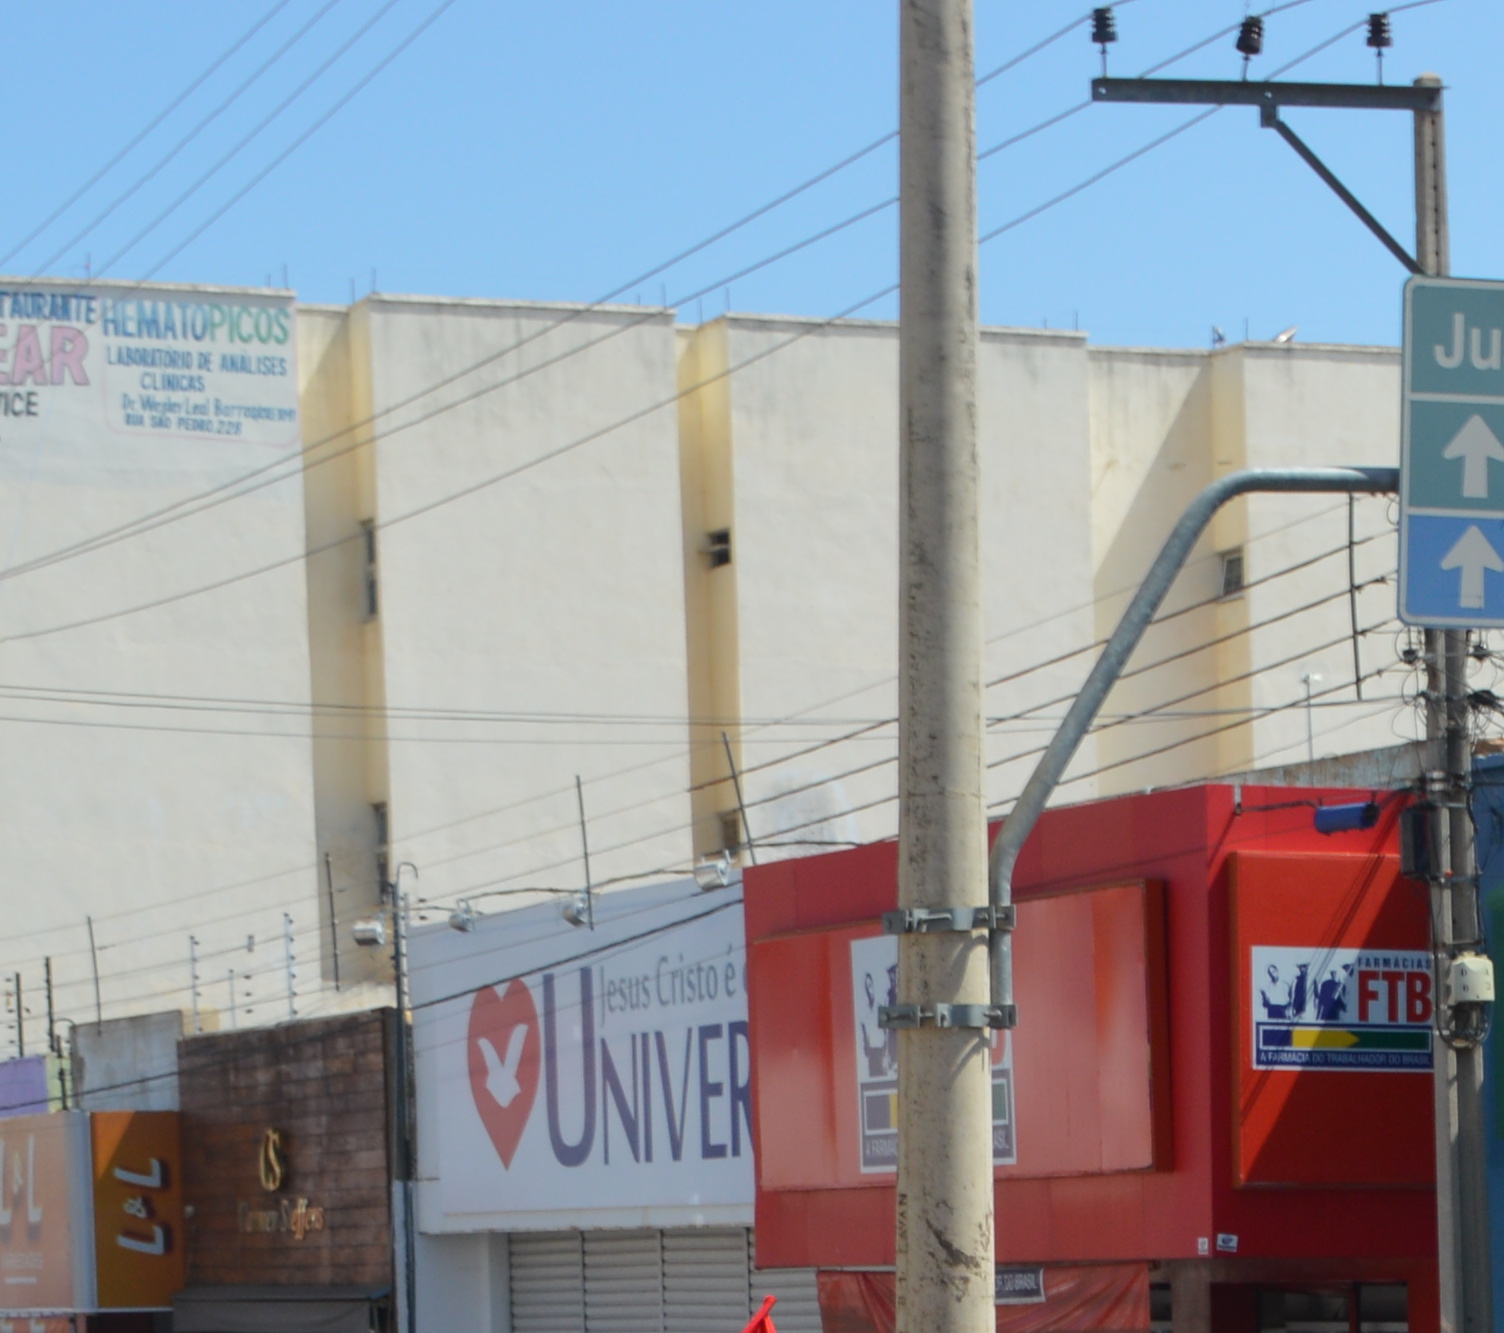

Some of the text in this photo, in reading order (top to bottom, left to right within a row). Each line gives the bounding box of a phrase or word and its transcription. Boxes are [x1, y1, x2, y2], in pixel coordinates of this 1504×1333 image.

[102, 298, 291, 345] HEMATOPICOS
[600, 964, 651, 1025] Jesus
[656, 954, 720, 1007] Cristo
[1357, 970, 1433, 1024] FTB
